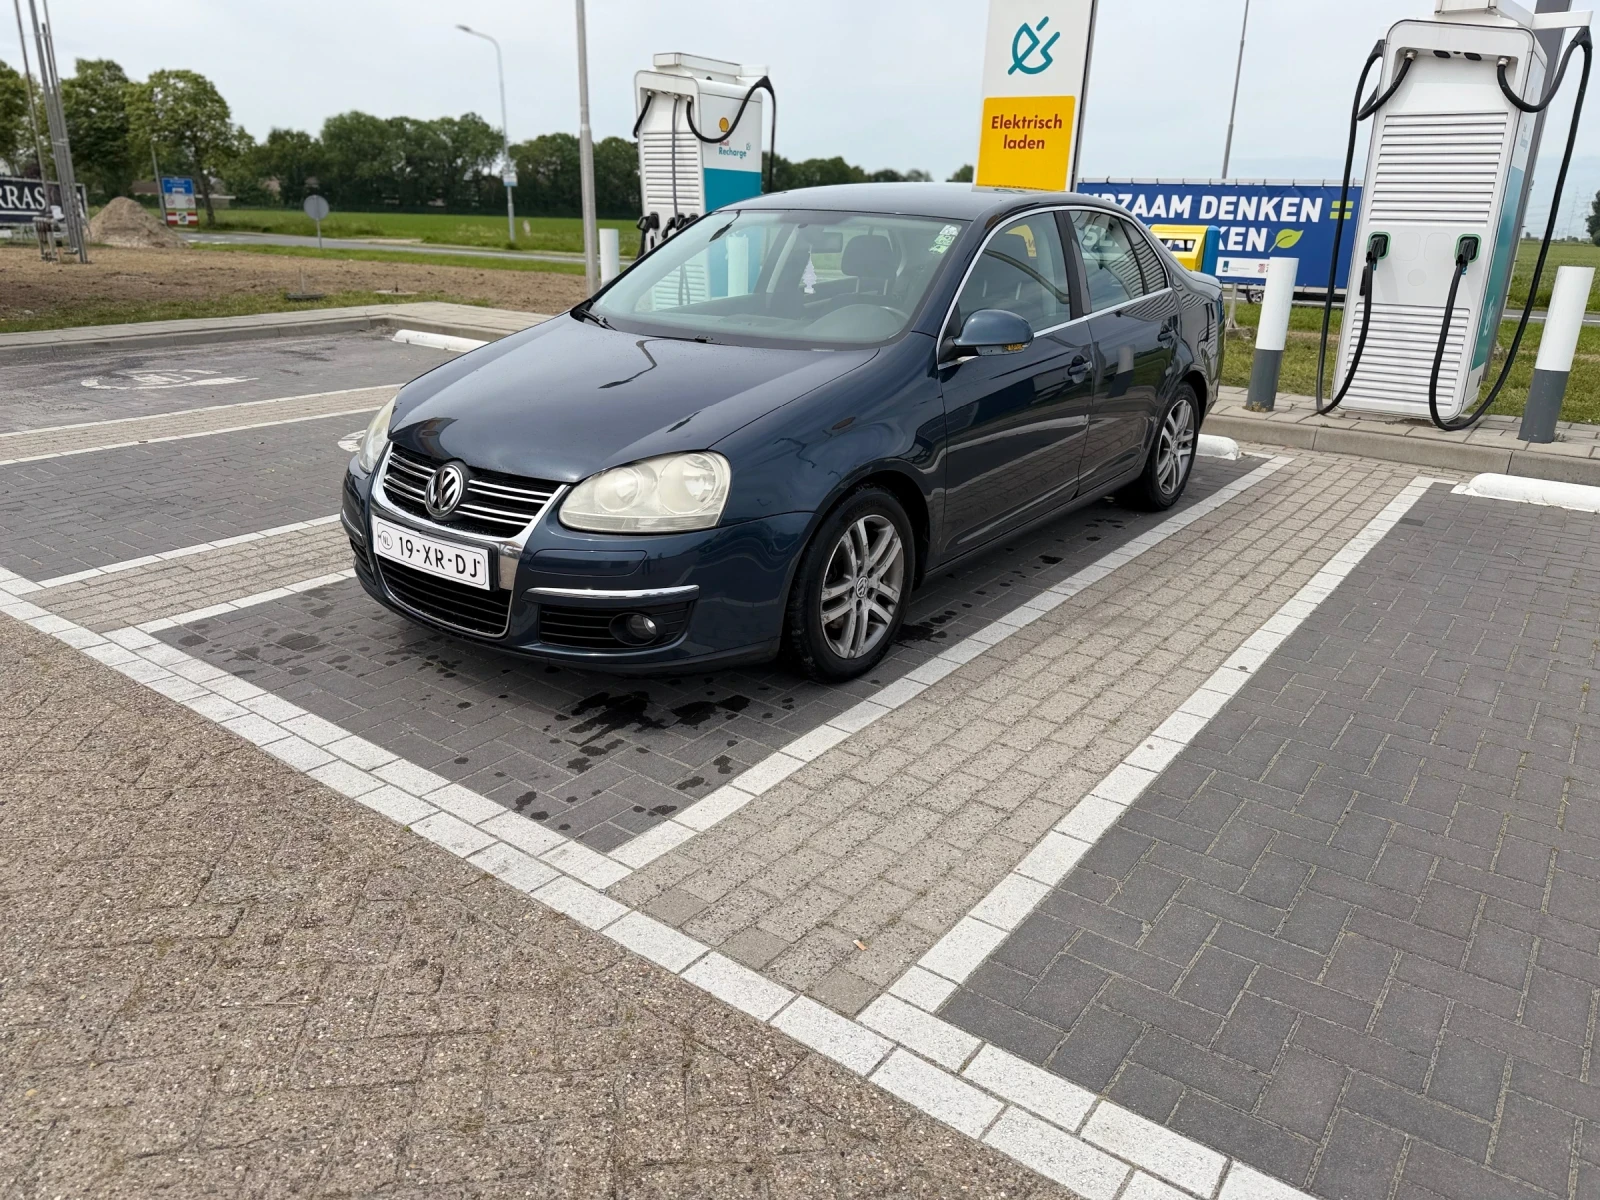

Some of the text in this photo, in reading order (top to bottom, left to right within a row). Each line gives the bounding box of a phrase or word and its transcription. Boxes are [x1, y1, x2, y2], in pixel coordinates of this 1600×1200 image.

[991, 113, 1063, 130] Elektrisch
[718, 146, 747, 159] Recharge
[1003, 134, 1046, 150] laden
[0, 185, 46, 211] RAS
[1084, 193, 1192, 219] ZAAM
[1199, 195, 1323, 223] DENKEN
[398, 536, 481, 578] 19-XR-DJ
